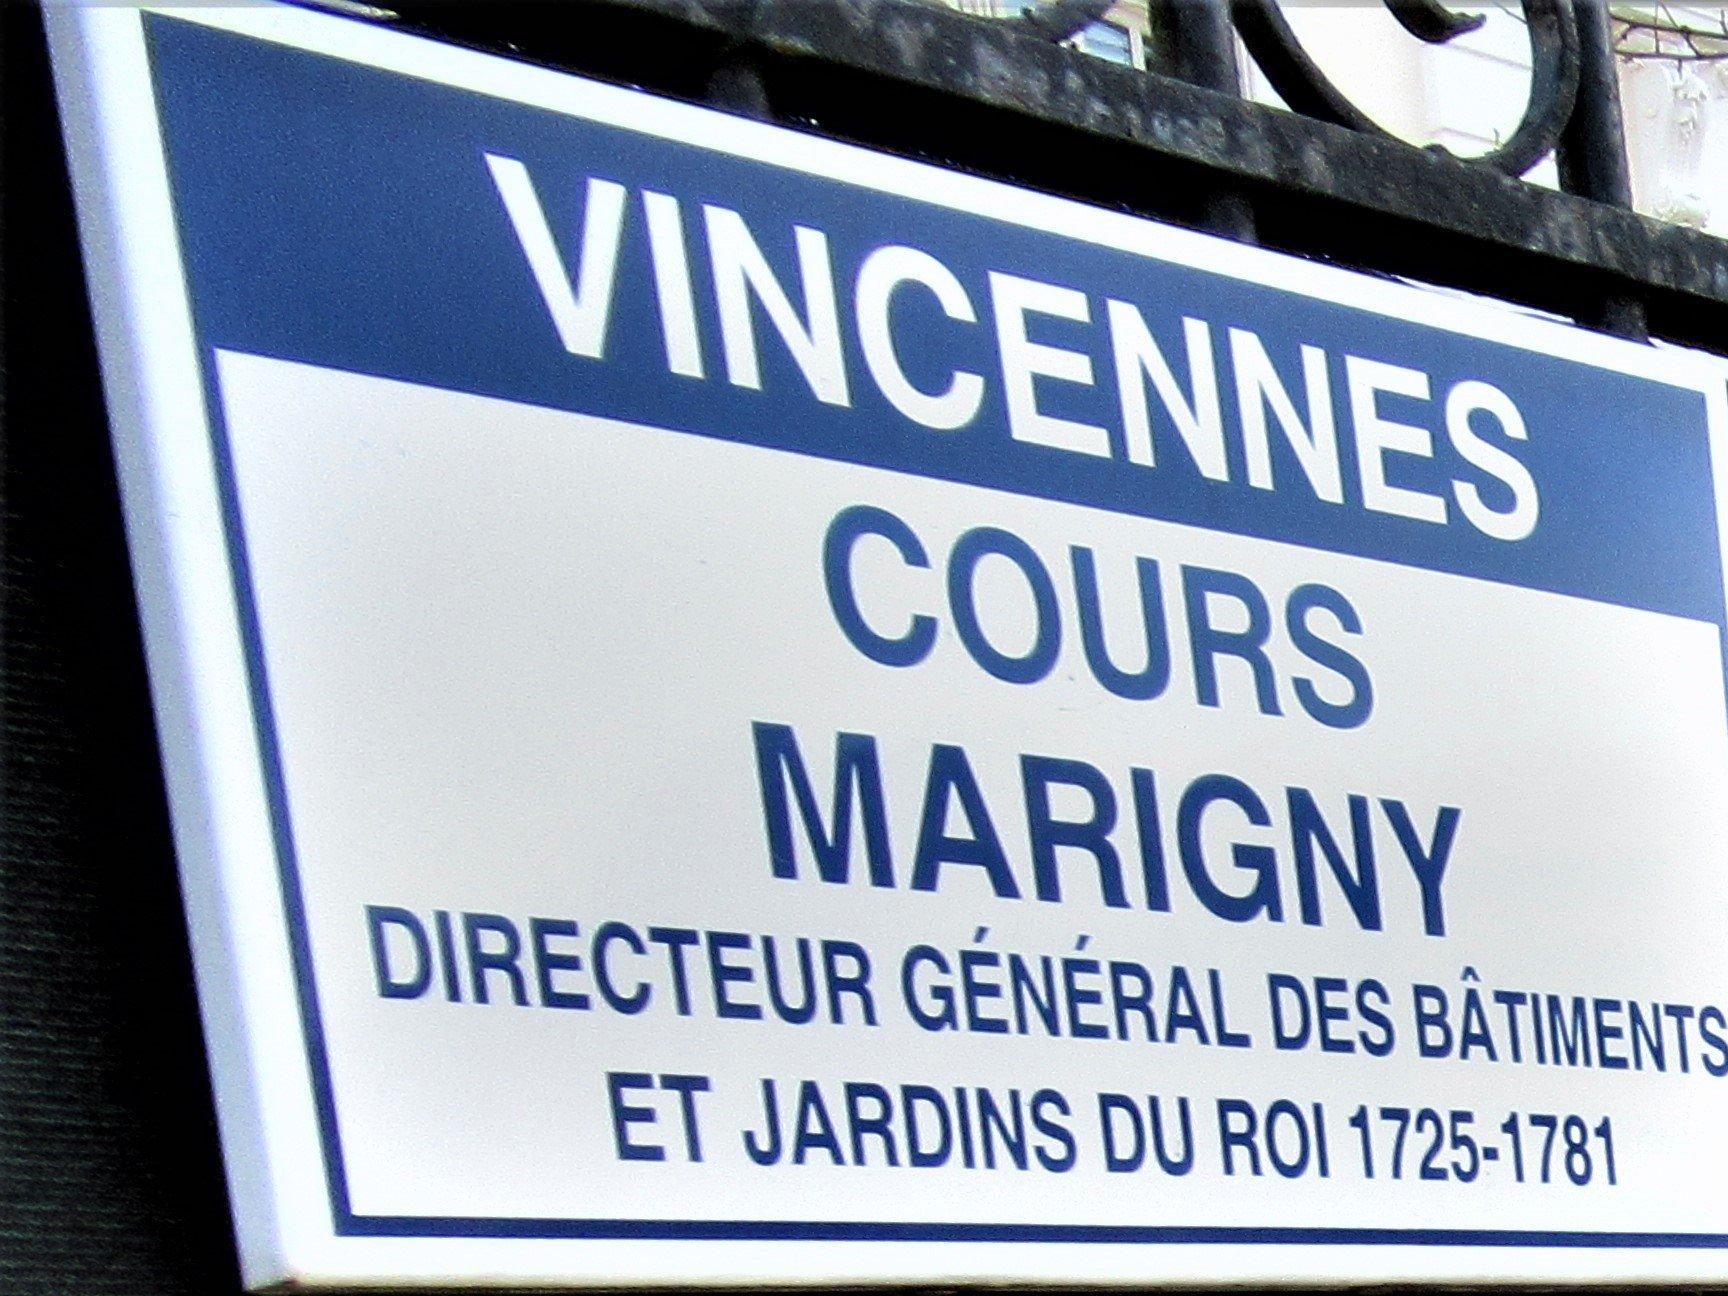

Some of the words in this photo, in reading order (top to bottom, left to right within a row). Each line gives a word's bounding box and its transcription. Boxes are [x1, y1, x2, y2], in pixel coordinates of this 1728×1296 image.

[485, 153, 1540, 541] VINCENNES
[822, 504, 1373, 730] COURS
[751, 721, 1461, 938] MARIGNY
[366, 905, 879, 1027] DIRECTEUR
[900, 927, 1252, 1048] GÉNÉRAL
[1267, 973, 1395, 1058] DES
[606, 1071, 711, 1163] ET
[743, 1078, 1077, 1174] JARDINS
[1097, 1092, 1194, 1177] DU
[1216, 1098, 1329, 1179] ROI
[1348, 1104, 1617, 1187] 1725-1781
